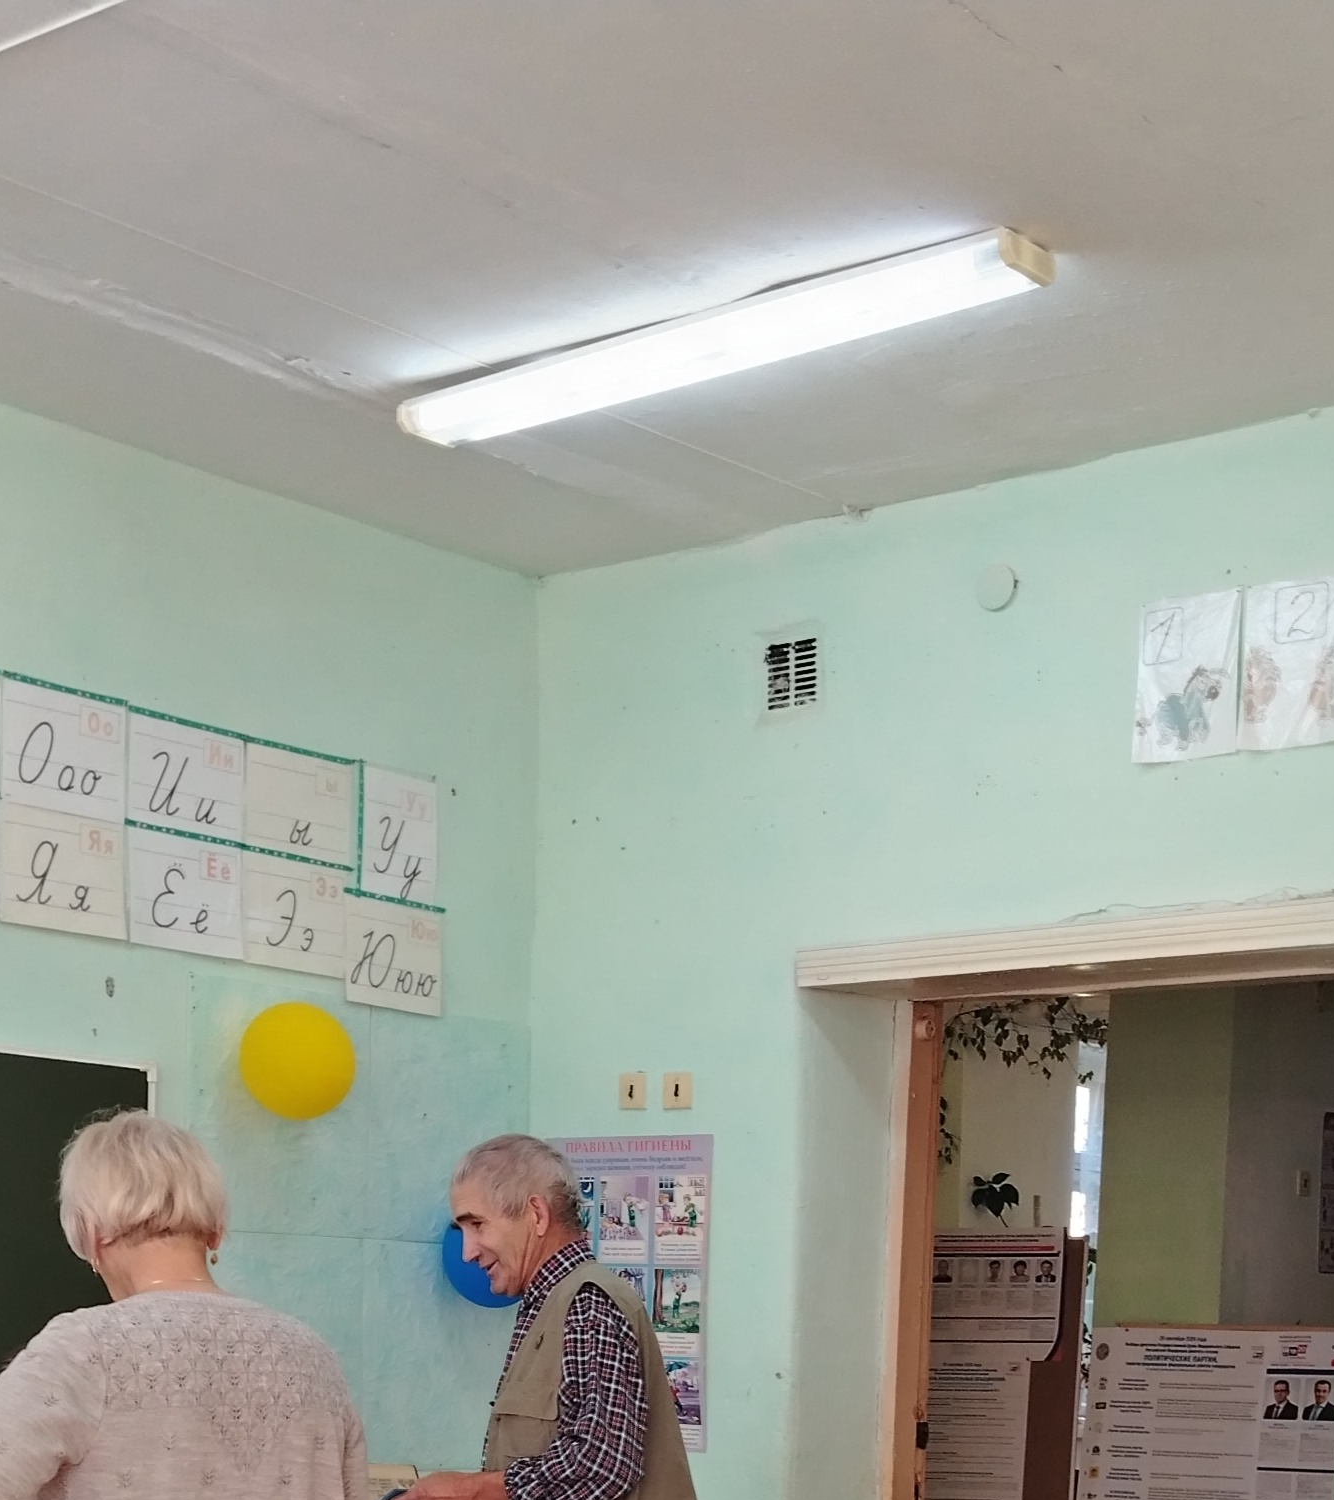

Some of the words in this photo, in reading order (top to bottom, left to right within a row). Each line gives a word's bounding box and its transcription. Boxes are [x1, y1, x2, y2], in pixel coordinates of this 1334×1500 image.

[1150, 613, 1176, 661] 1
[1289, 591, 1313, 638] 2
[288, 819, 313, 847] ы
[566, 1141, 623, 1153] ПРАВИЛА
[628, 1140, 691, 1152] ГИГИЕНЫ
